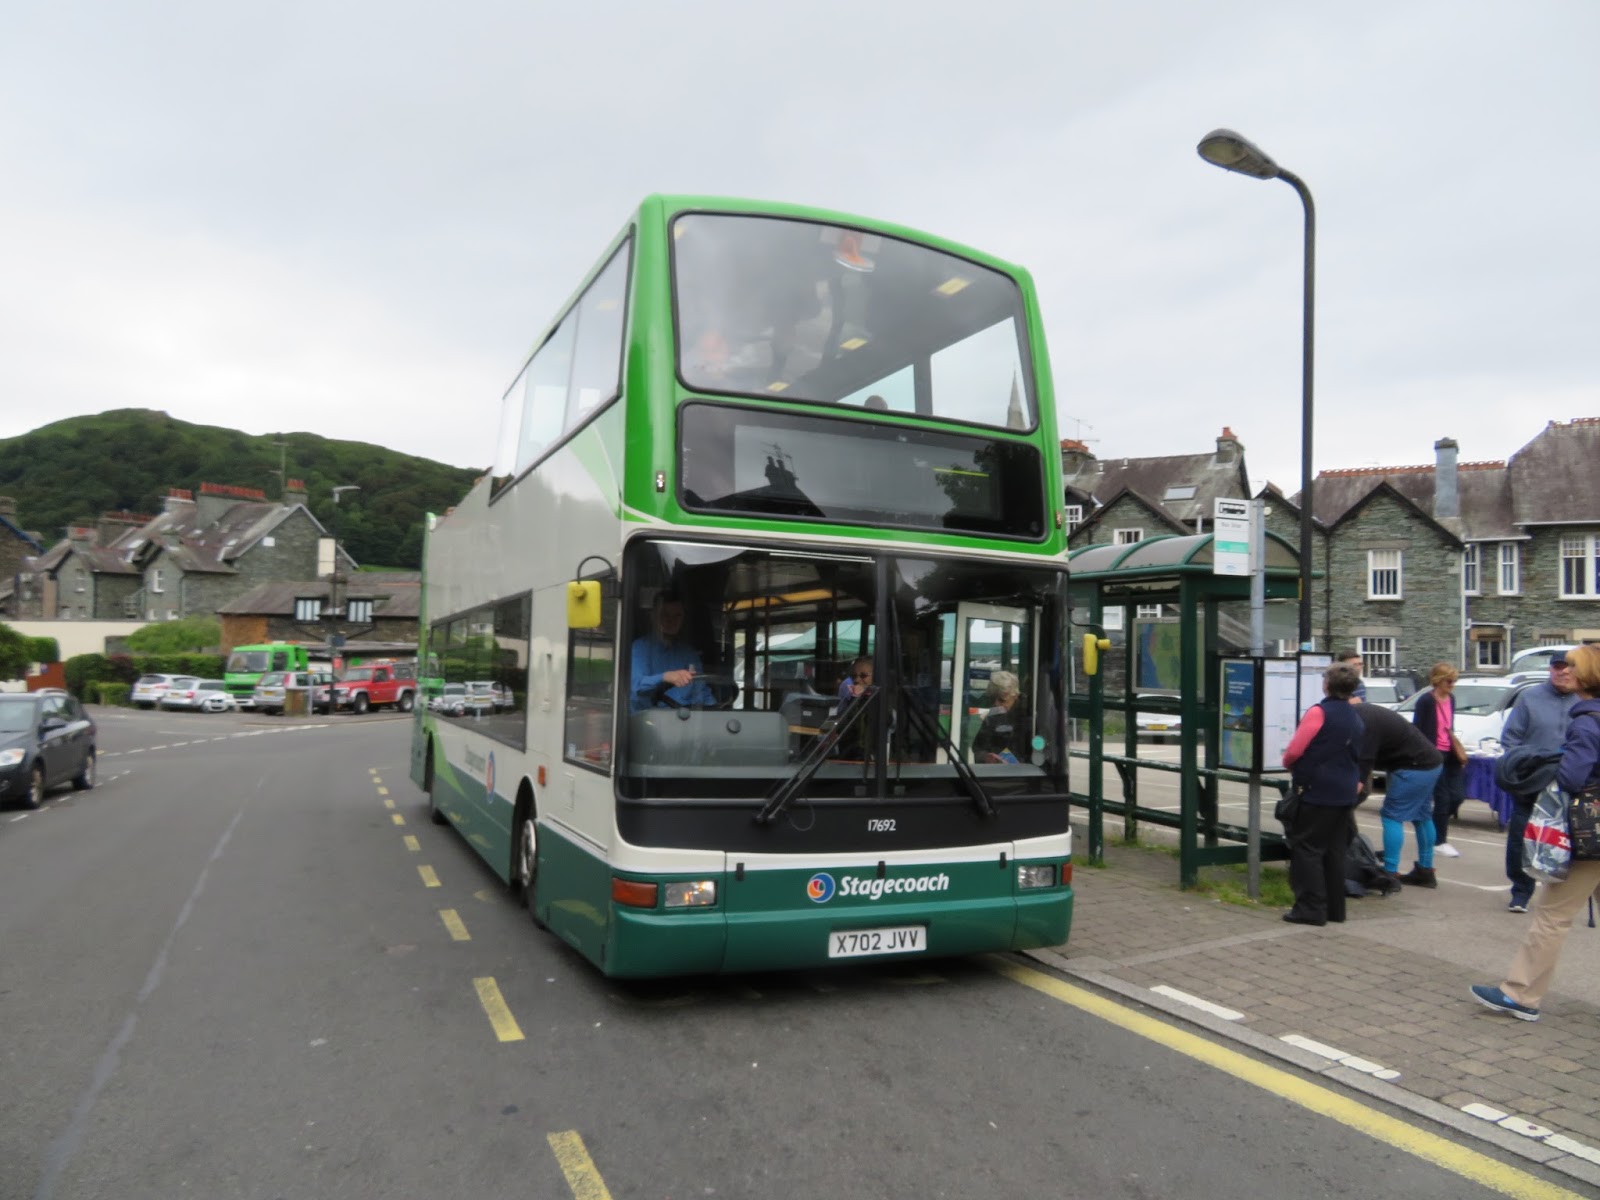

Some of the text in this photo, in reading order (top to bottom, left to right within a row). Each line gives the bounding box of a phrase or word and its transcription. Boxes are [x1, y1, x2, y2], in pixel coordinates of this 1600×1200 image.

[867, 818, 896, 832] 17692
[839, 873, 949, 900] Stagecoach
[837, 930, 918, 954] X702 JVV
